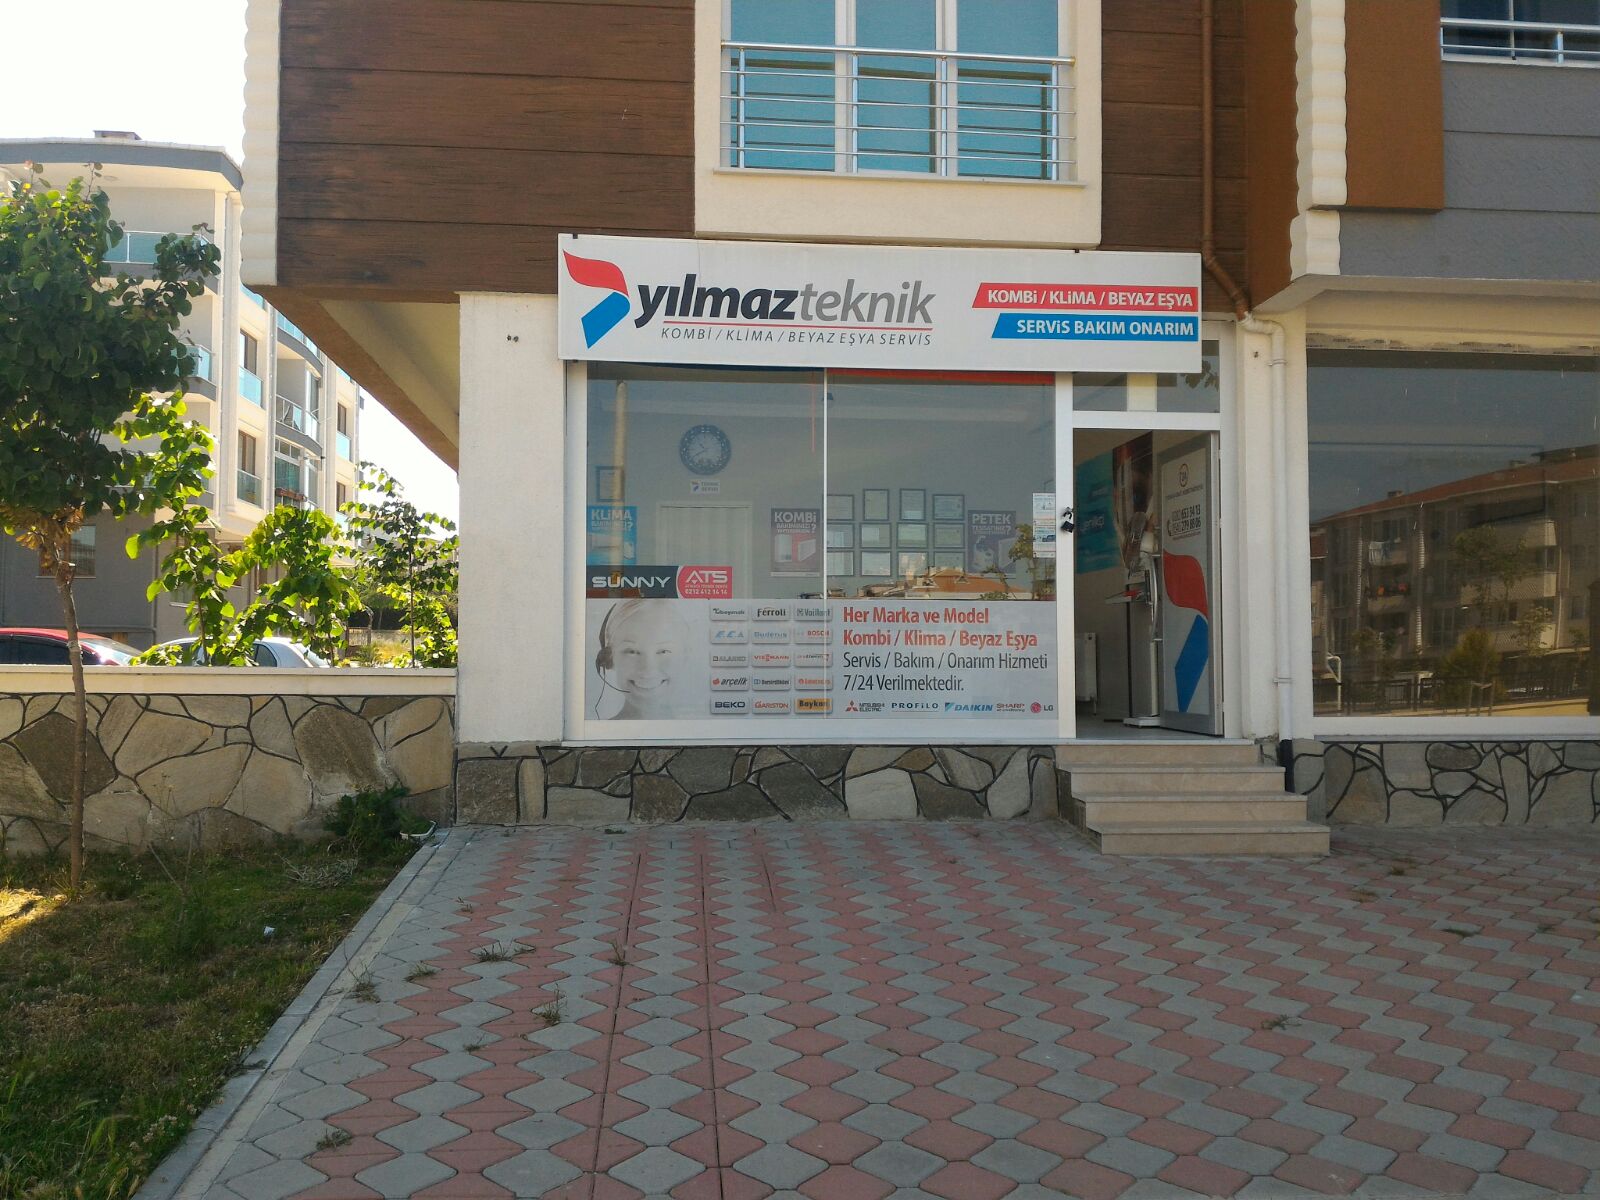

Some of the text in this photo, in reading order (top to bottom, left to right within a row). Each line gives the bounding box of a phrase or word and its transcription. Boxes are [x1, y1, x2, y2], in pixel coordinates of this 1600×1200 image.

[1040, 290, 1047, 305] /
[1099, 292, 1105, 306] /
[1109, 292, 1155, 306] BEYAZ
[1158, 293, 1193, 309] EŞYA
[661, 327, 931, 347] KOMBİ / KLİMA / BEYAZ EŞYA SERVİS
[1074, 320, 1125, 335] BAKIM
[1130, 321, 1194, 336] ONARIM
[972, 513, 1011, 524] PETEK
[591, 576, 671, 588] SUNNY
[685, 570, 728, 584] ATS
[757, 607, 786, 617] Ferroli
[843, 606, 989, 624] Her Marka ve Model
[843, 629, 1037, 650] Kombi / Klima / Beyaz Eşya
[843, 651, 1048, 669] Servis / Bakım / Onarım Hizmeti
[844, 674, 964, 692] 7/24 Verilmektedir.
